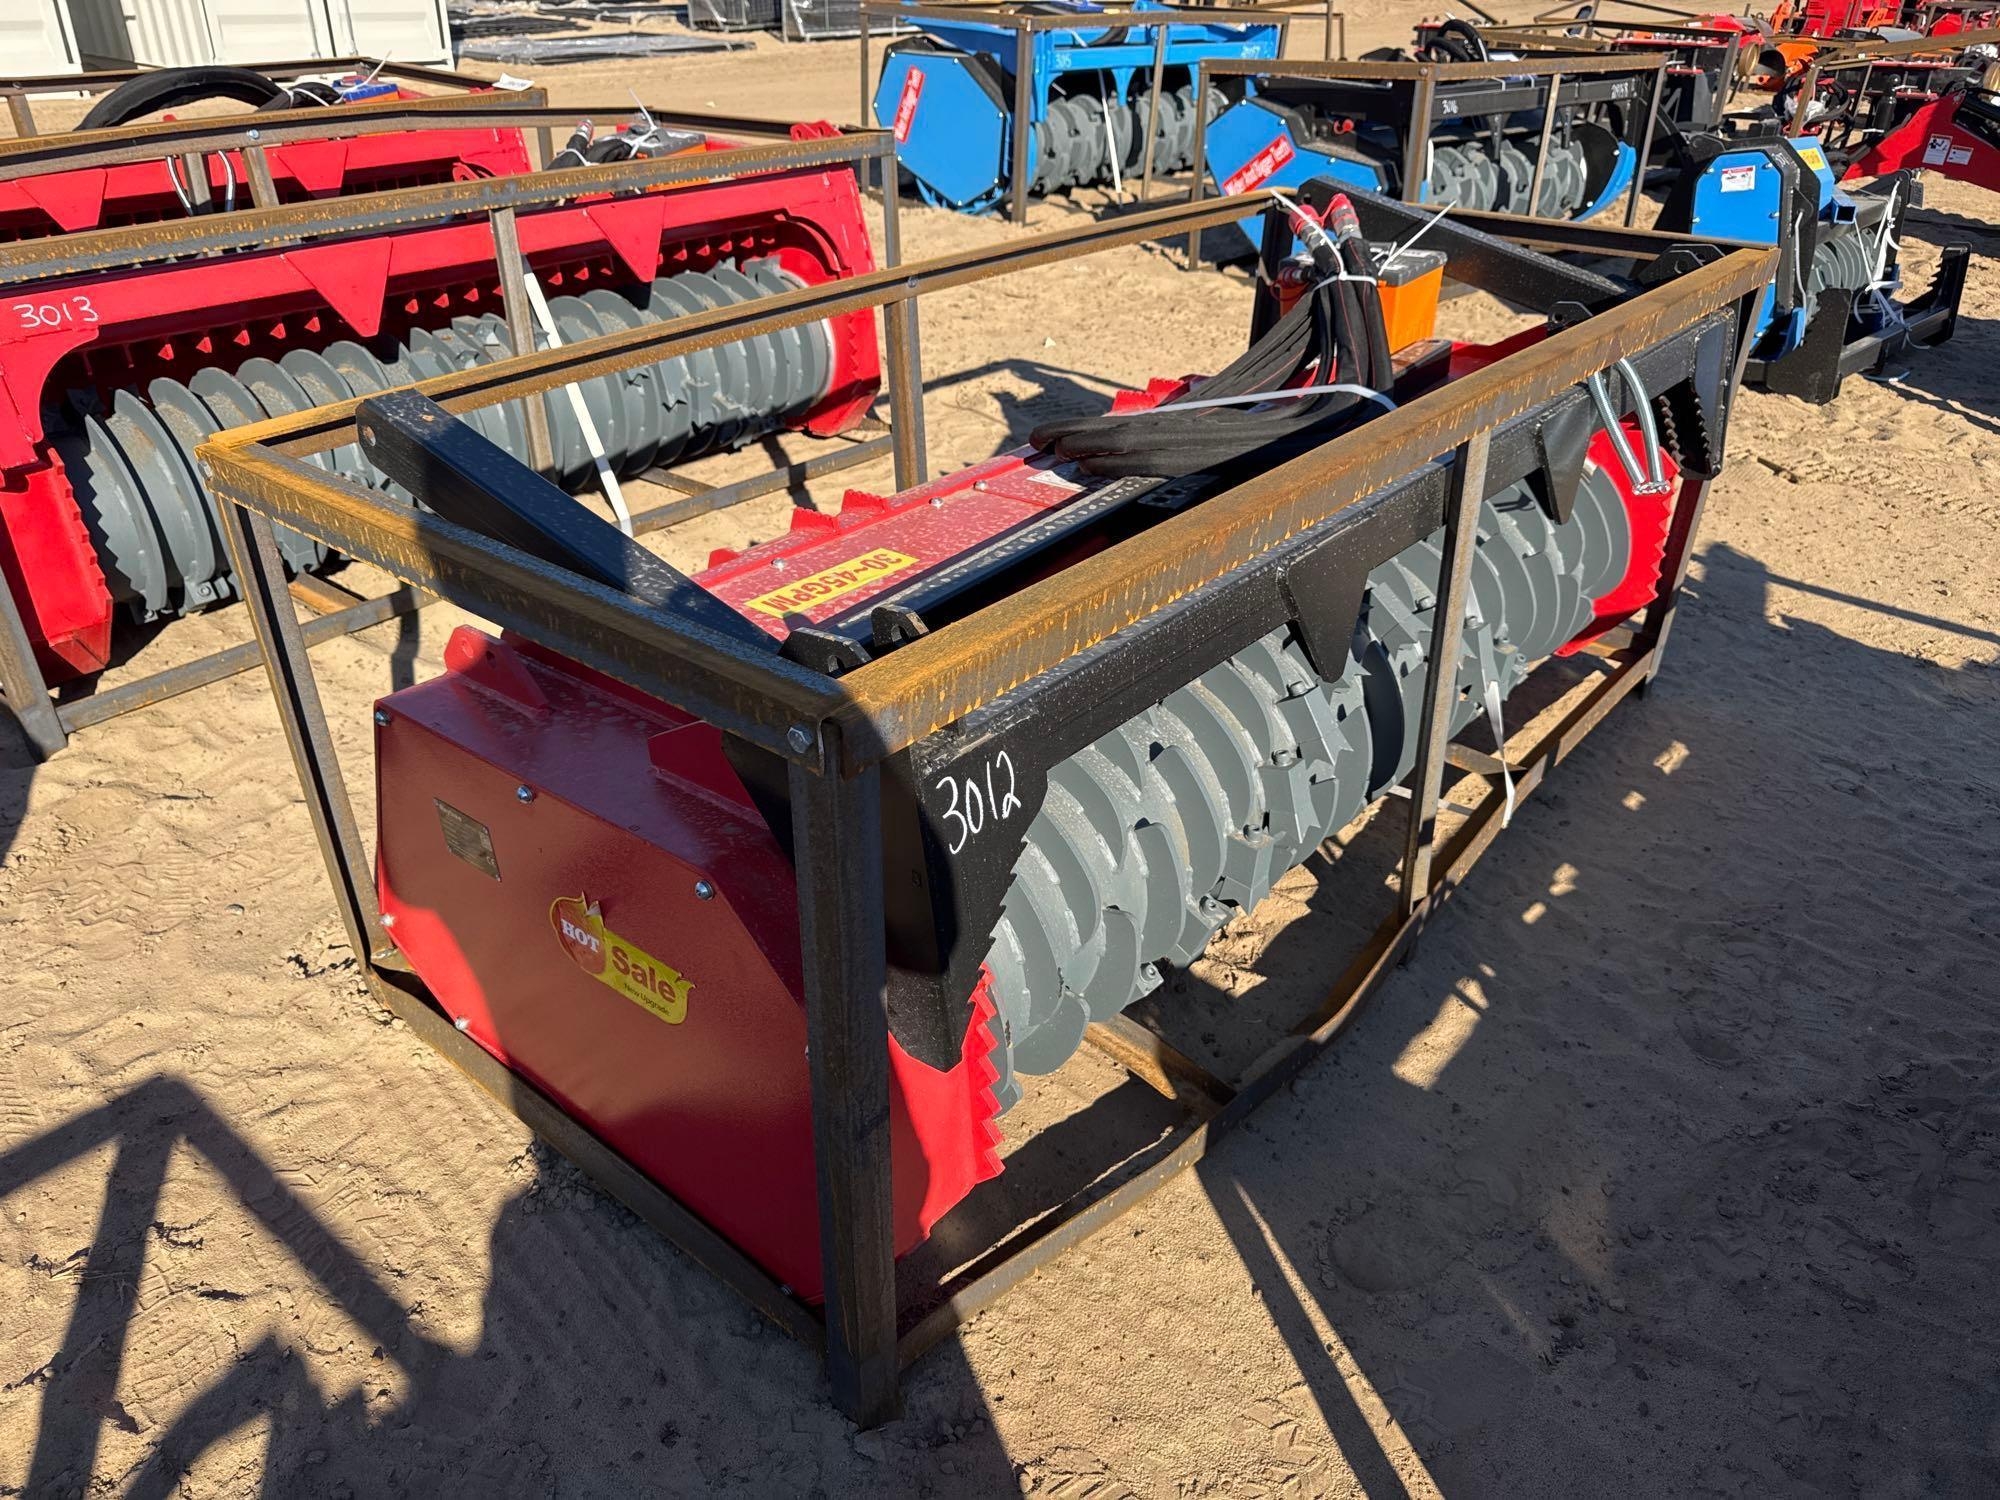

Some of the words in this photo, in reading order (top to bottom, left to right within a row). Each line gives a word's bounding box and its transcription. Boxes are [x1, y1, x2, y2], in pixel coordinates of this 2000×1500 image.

[12, 296, 99, 328] 3013
[935, 750, 1022, 855] 3012
[561, 918, 600, 953] HOT
[611, 946, 676, 1003] Sale
[624, 983, 640, 997] New
